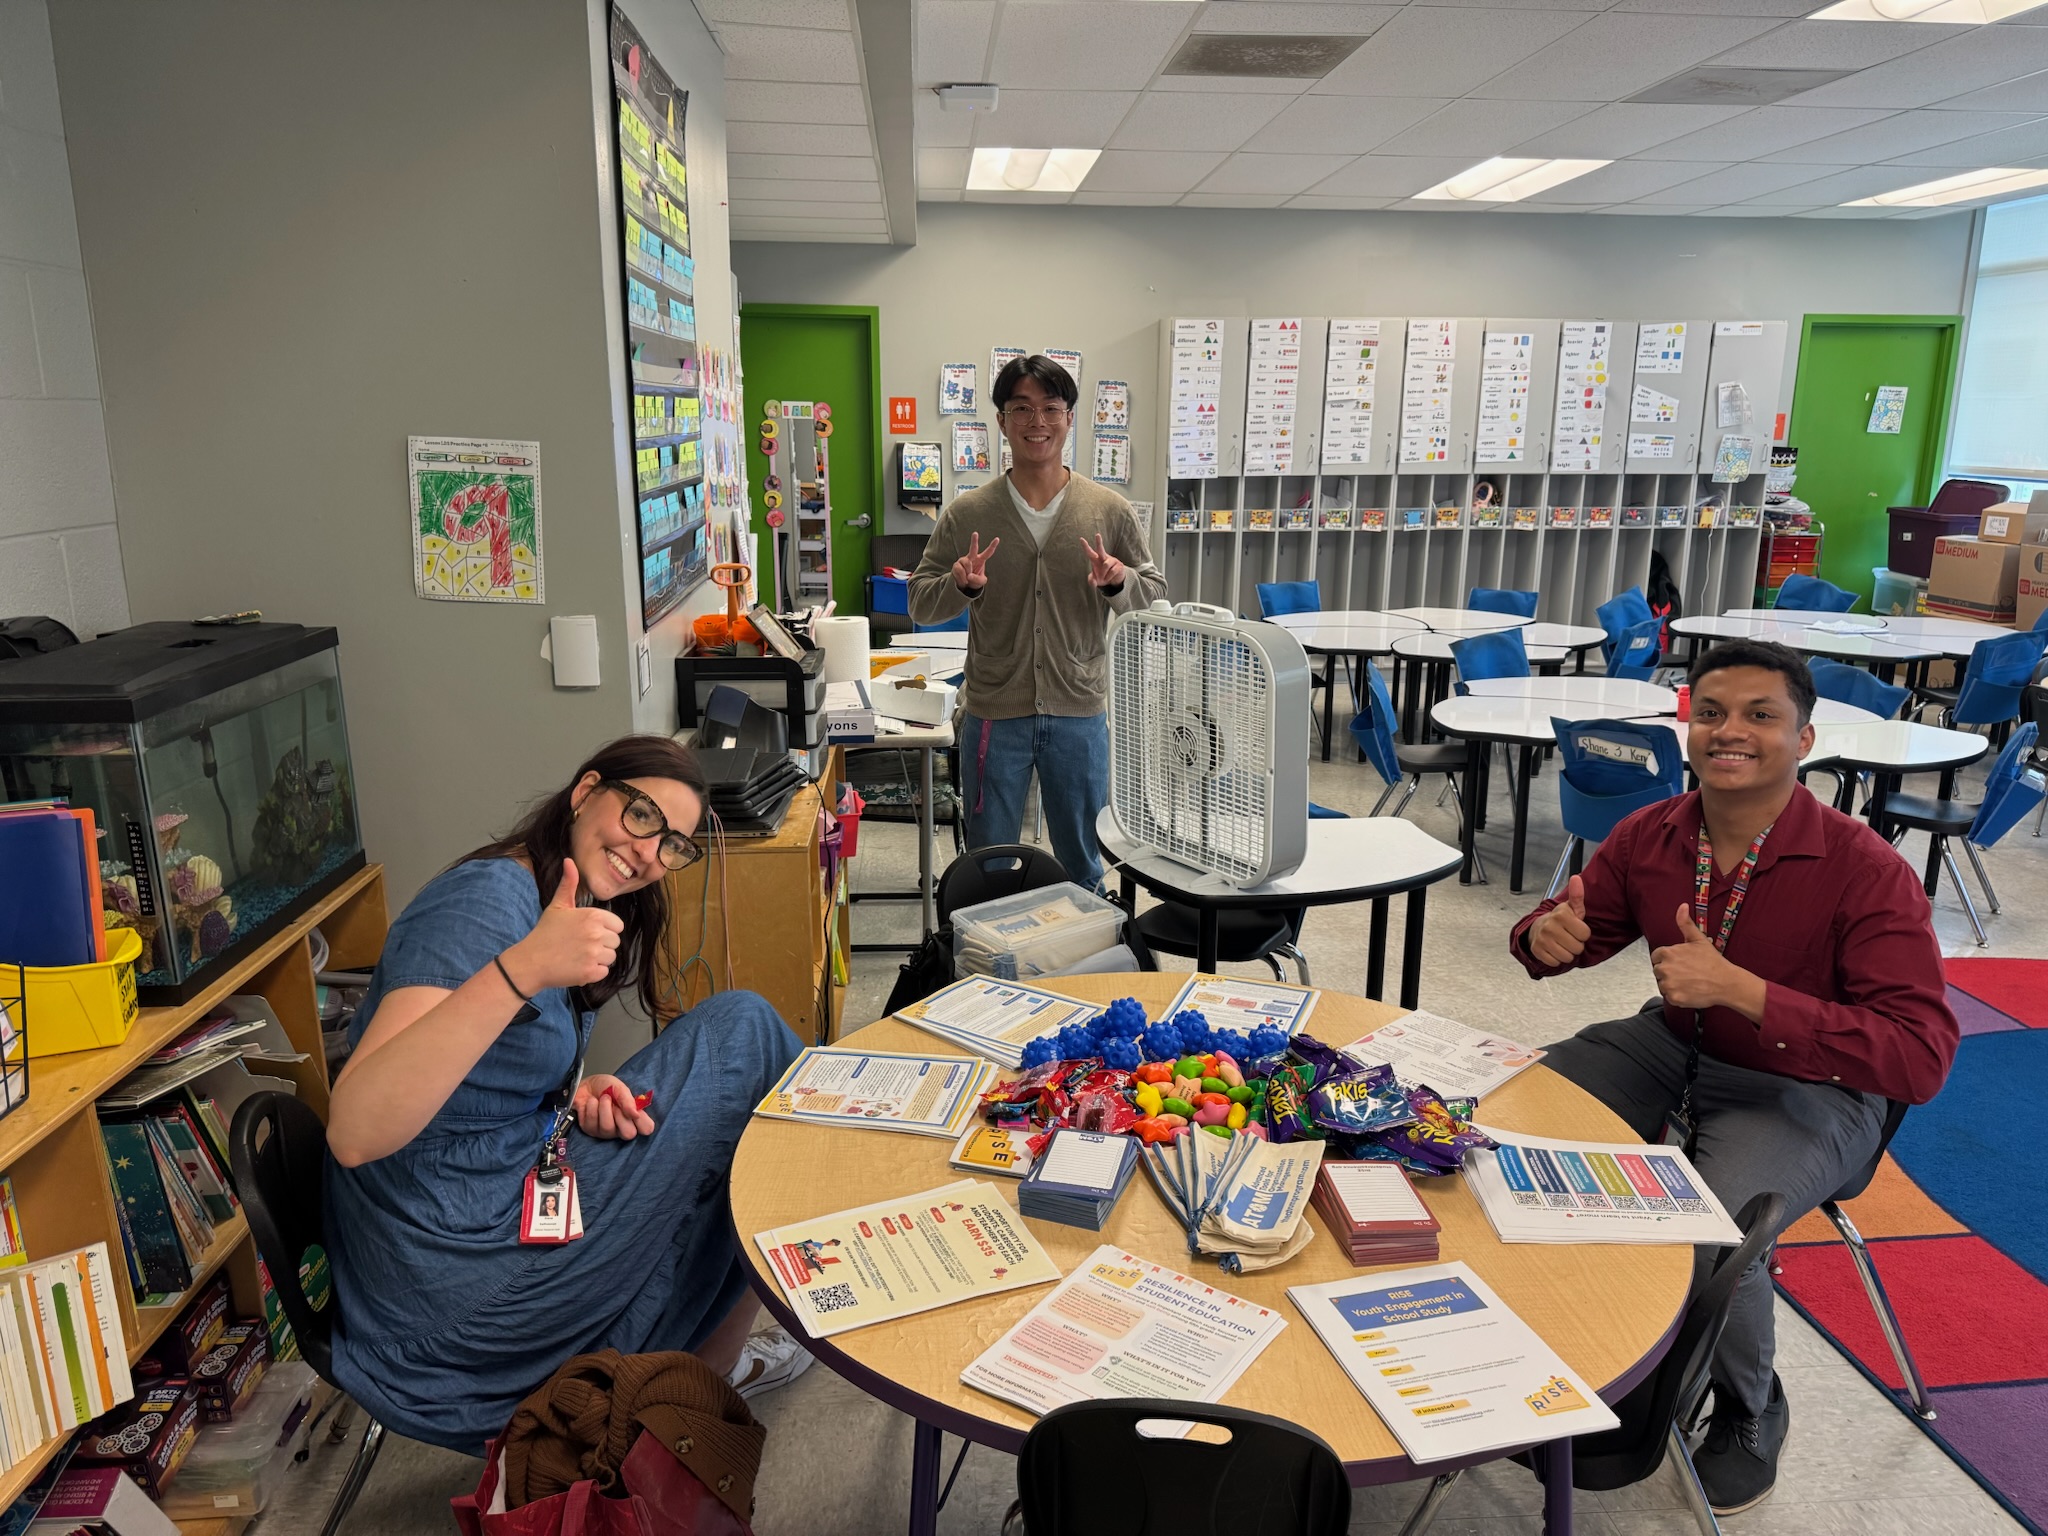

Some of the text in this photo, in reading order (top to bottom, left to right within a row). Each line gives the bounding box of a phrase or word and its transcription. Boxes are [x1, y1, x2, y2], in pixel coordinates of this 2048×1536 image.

[783, 406, 812, 417] I AM
[1945, 547, 1978, 559] MEDIUM
[826, 722, 858, 733] yons
[1582, 738, 1622, 758] Shane 3
[1268, 1079, 1295, 1124] Takis
[1321, 1081, 1368, 1102] Takis
[987, 1128, 1008, 1162] RISE
[1079, 1134, 1105, 1143] ATOM
[1252, 1166, 1267, 1189] Advanced
[1259, 1175, 1268, 1190] Tools
[1268, 1159, 1286, 1192] Organization
[1276, 1158, 1295, 1191] Management
[1281, 1159, 1311, 1223] theatomprogram.com
[1241, 1192, 1273, 1229] ATOM
[961, 1218, 996, 1257] EARN $35
[969, 1206, 1016, 1265] AND TEACHERS TO EACH
[977, 1203, 1024, 1263] STUDENTS, CAREGIVERS,
[990, 1208, 1029, 1254] OPPORTUNITY FOR
[1094, 1266, 1140, 1278] RISE
[1099, 1292, 1122, 1304] WHY?
[1142, 1277, 1221, 1312] RESILIENCE IN
[1351, 1291, 1464, 1318] Youth Engagement in
[1388, 1290, 1414, 1300] RISE
[191, 1315, 206, 1343] EARTH
[211, 1294, 227, 1310] SPACE
[1134, 1285, 1256, 1336] STUDENT EDUCATION
[1382, 1304, 1452, 1324] School Study
[1060, 1324, 1088, 1338] WHAT?
[1186, 1329, 1209, 1340] WHO?
[232, 1362, 246, 1391] EARTH
[251, 1340, 266, 1357] SPACE
[976, 1365, 987, 1373] FOR
[988, 1371, 1006, 1382] MORE
[1003, 1354, 1058, 1381] INTERESTED?
[1122, 1350, 1152, 1365] WHAT'S
[1169, 1371, 1185, 1379] FOR
[1184, 1376, 1206, 1388] YOU?
[1420, 1402, 1456, 1414] interested
[1532, 1380, 1569, 1411] RISE
[158, 1431, 174, 1465] EARTH
[179, 1400, 197, 1421] SPACE
[162, 1432, 180, 1468] SCIENCE
[179, 1409, 198, 1433] VIEWER
